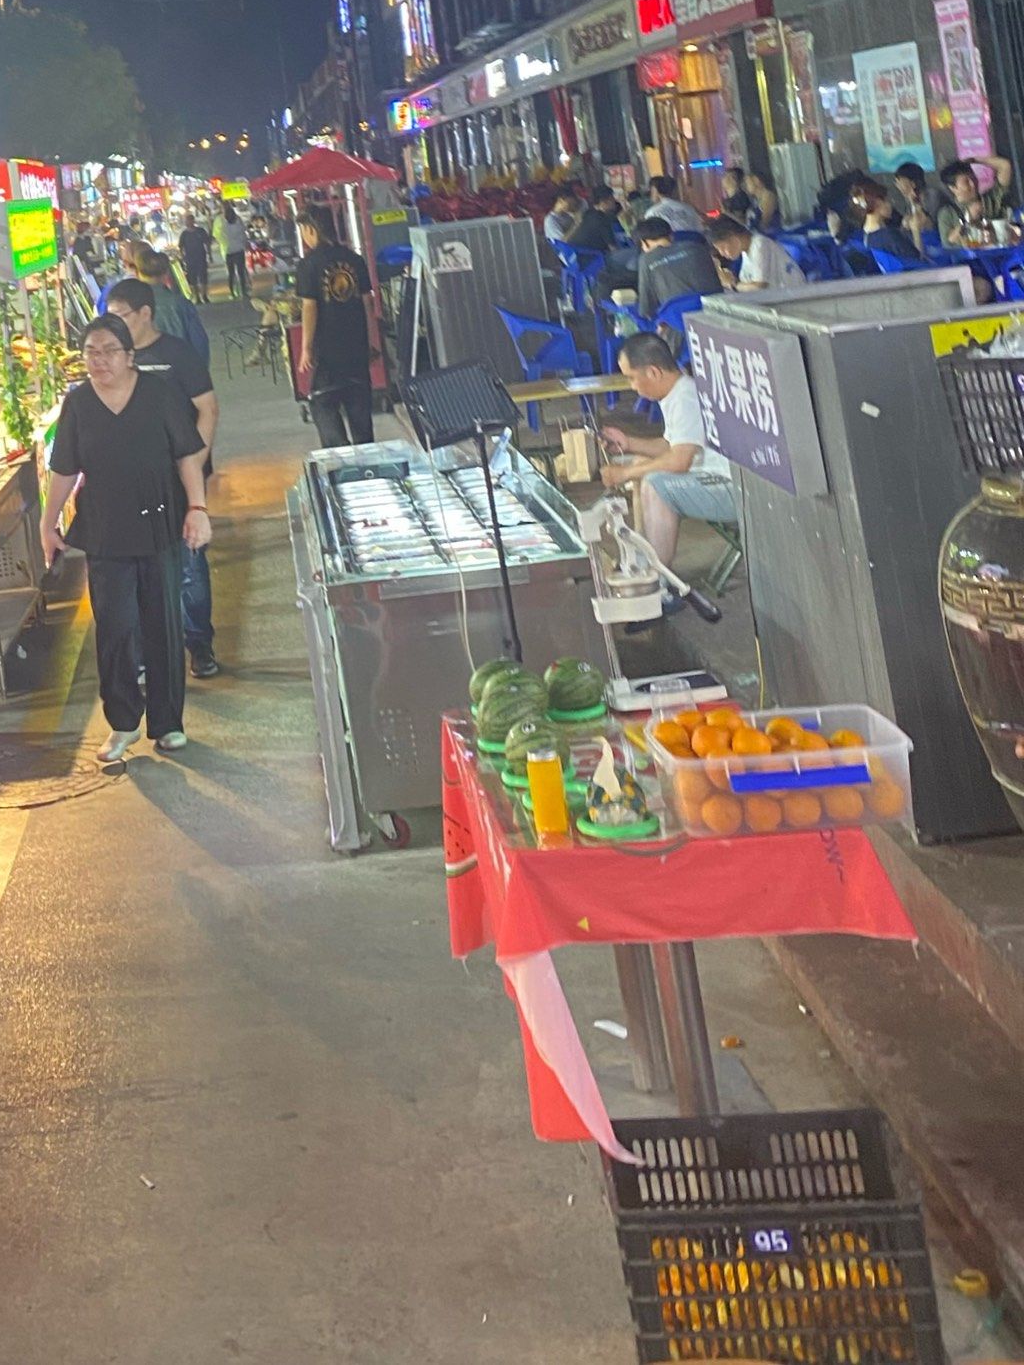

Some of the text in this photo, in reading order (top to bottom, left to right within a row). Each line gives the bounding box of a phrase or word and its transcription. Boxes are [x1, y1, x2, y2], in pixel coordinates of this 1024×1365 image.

[704, 337, 779, 437] 水果捞
[754, 1230, 788, 1252] 95
